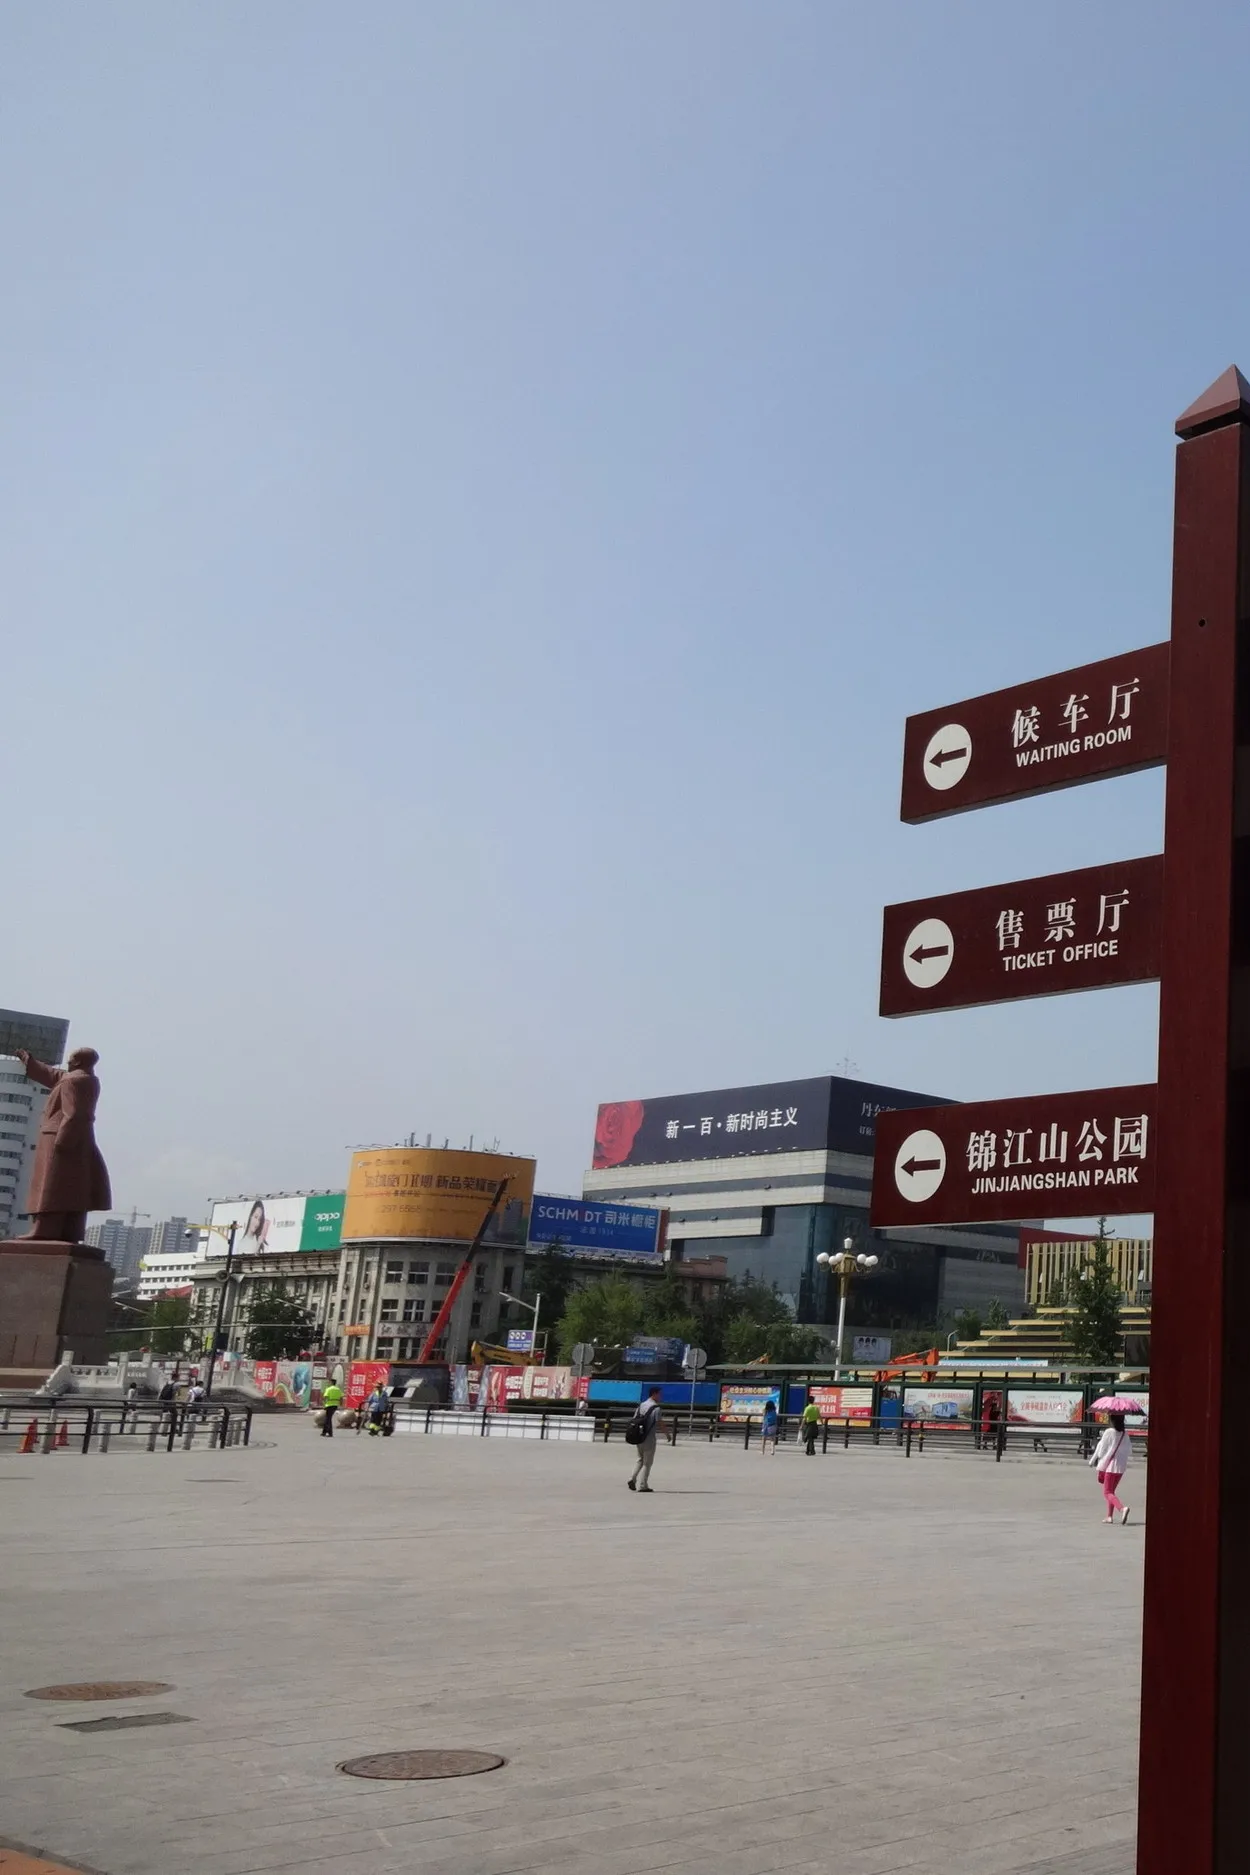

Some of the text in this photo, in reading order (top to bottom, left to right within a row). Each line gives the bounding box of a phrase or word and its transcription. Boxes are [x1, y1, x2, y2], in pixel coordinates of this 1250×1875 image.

[1011, 677, 1141, 749] 候车厅
[1015, 725, 1132, 768] WAITING ROOM
[995, 888, 1130, 952] 售票厅
[1002, 939, 1118, 973] TICKET OFFICE
[965, 1113, 1149, 1173] 锦江山公园
[971, 1166, 1139, 1195] JINJIANGSHAN PARK
